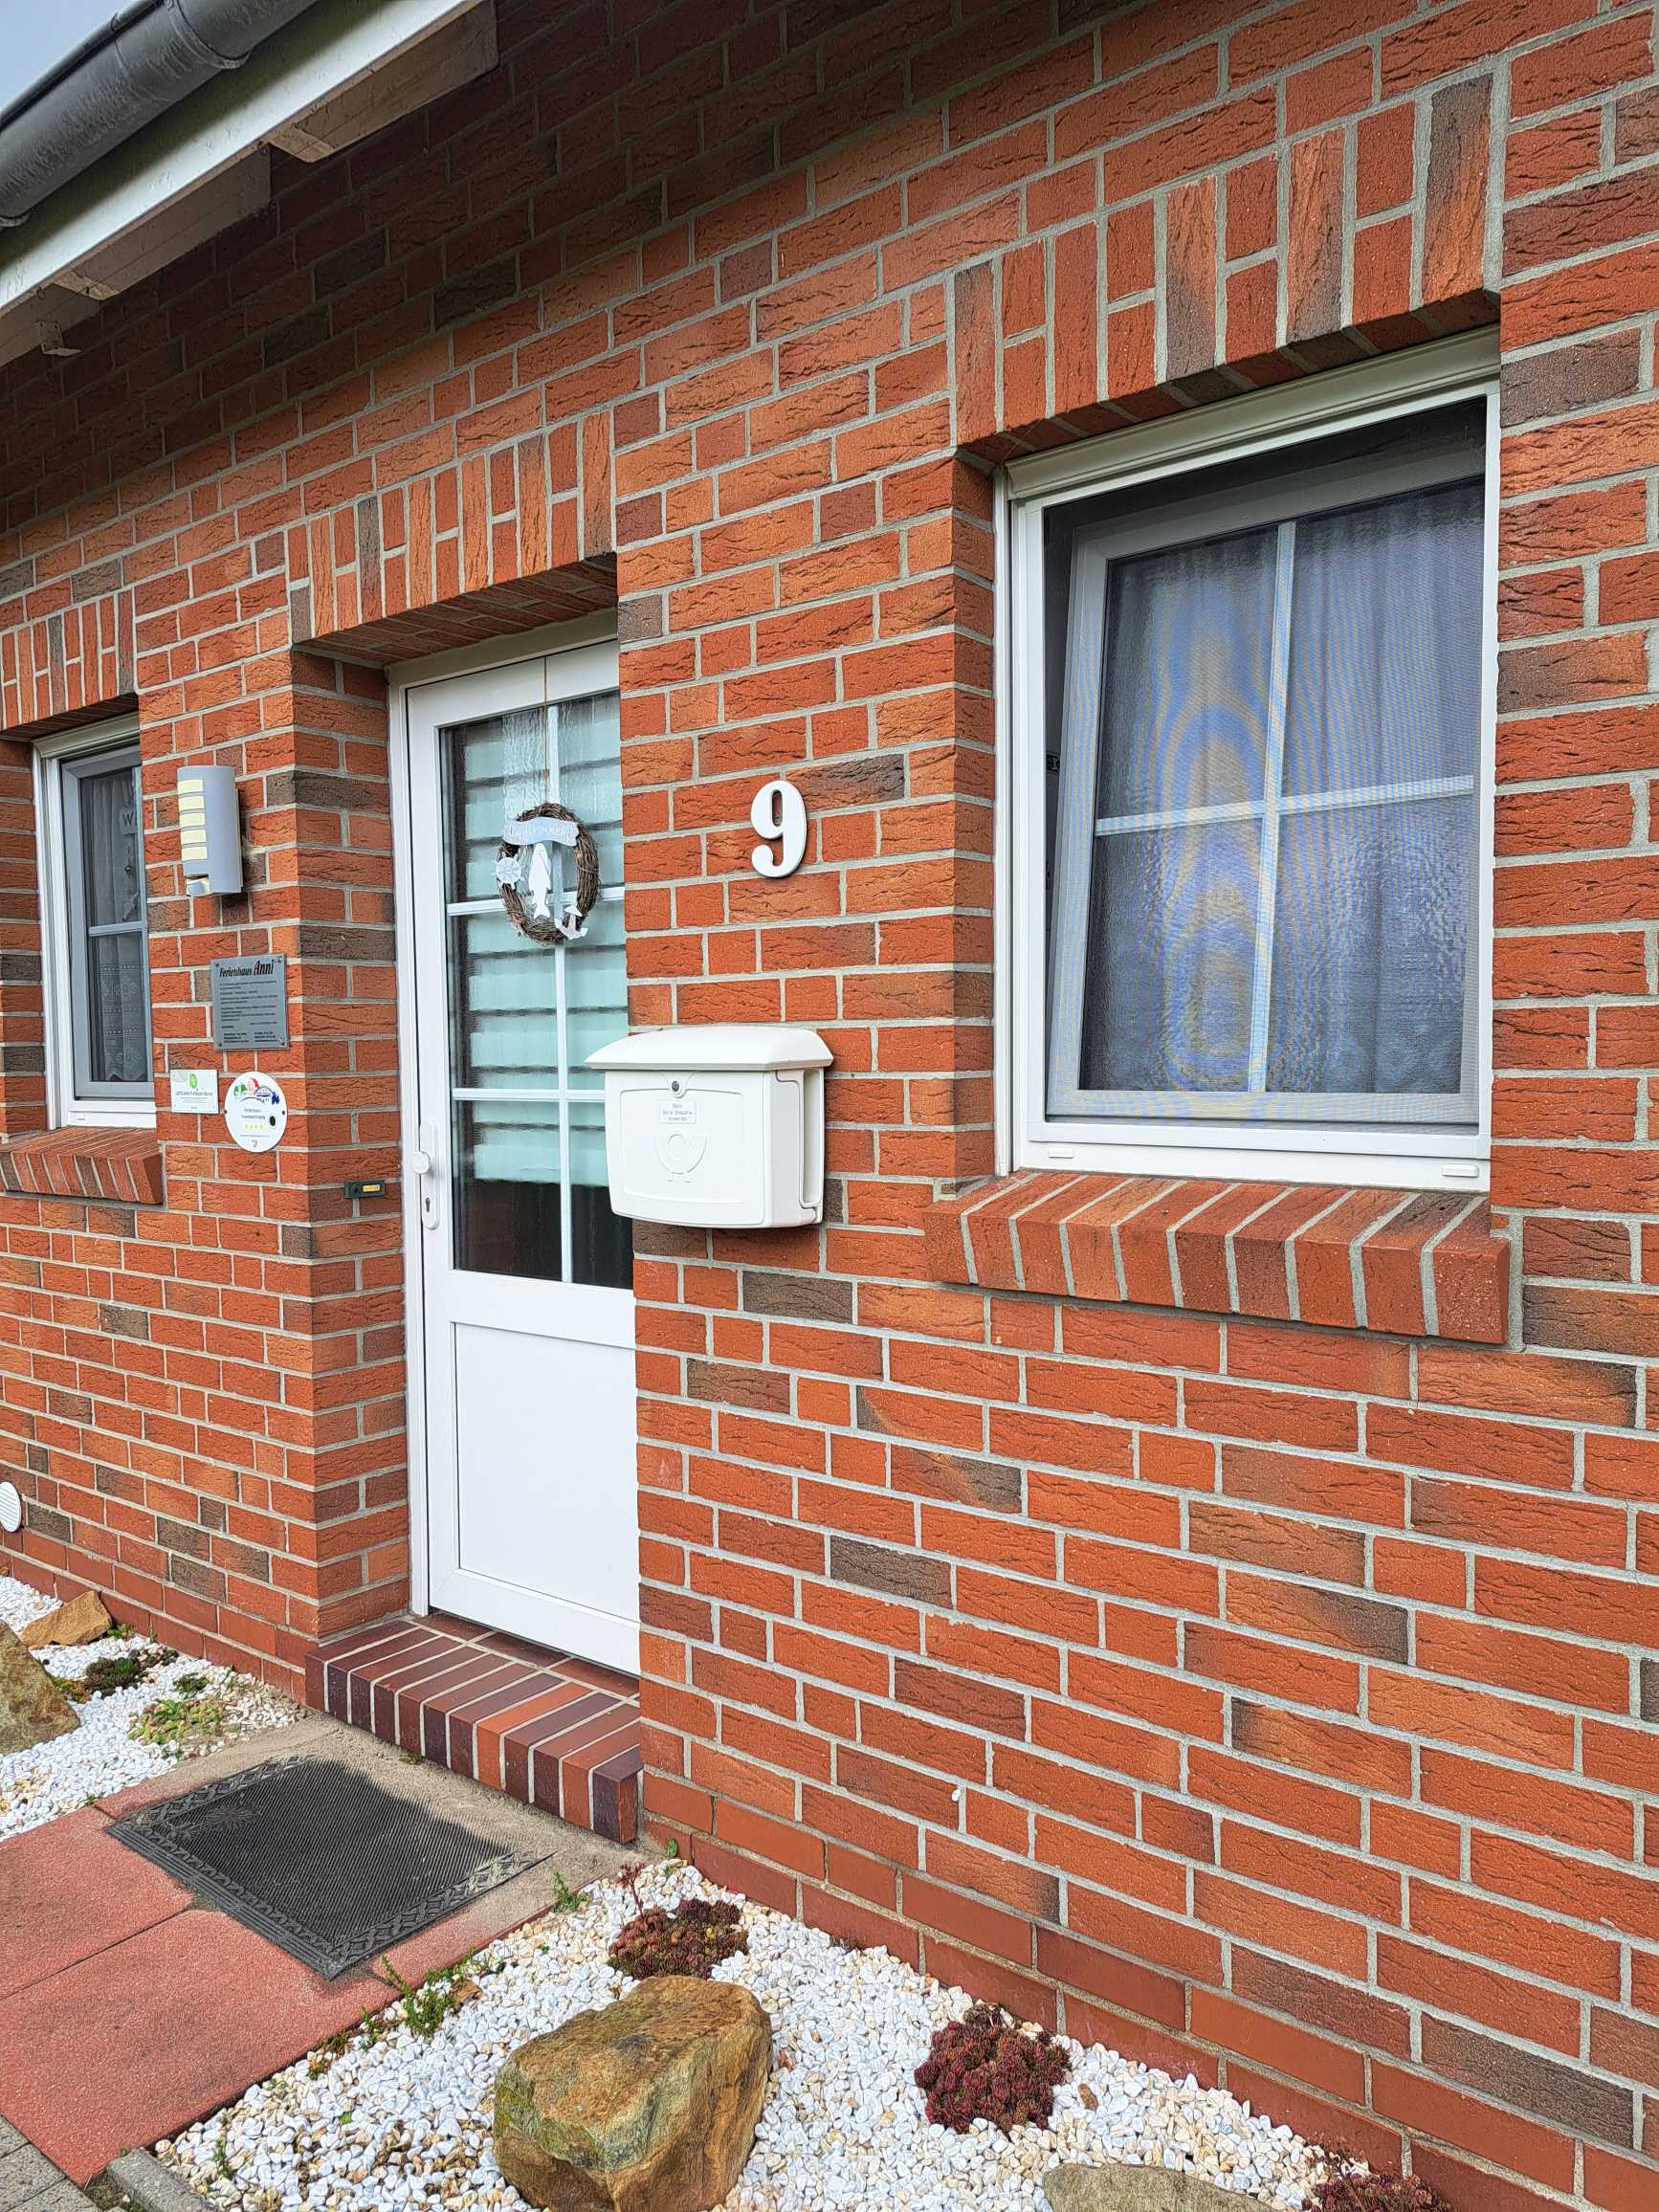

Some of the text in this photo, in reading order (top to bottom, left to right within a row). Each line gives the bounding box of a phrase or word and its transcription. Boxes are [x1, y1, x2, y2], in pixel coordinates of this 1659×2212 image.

[750, 780, 807, 877] 9
[219, 959, 275, 978] Ferienhaus Anni
